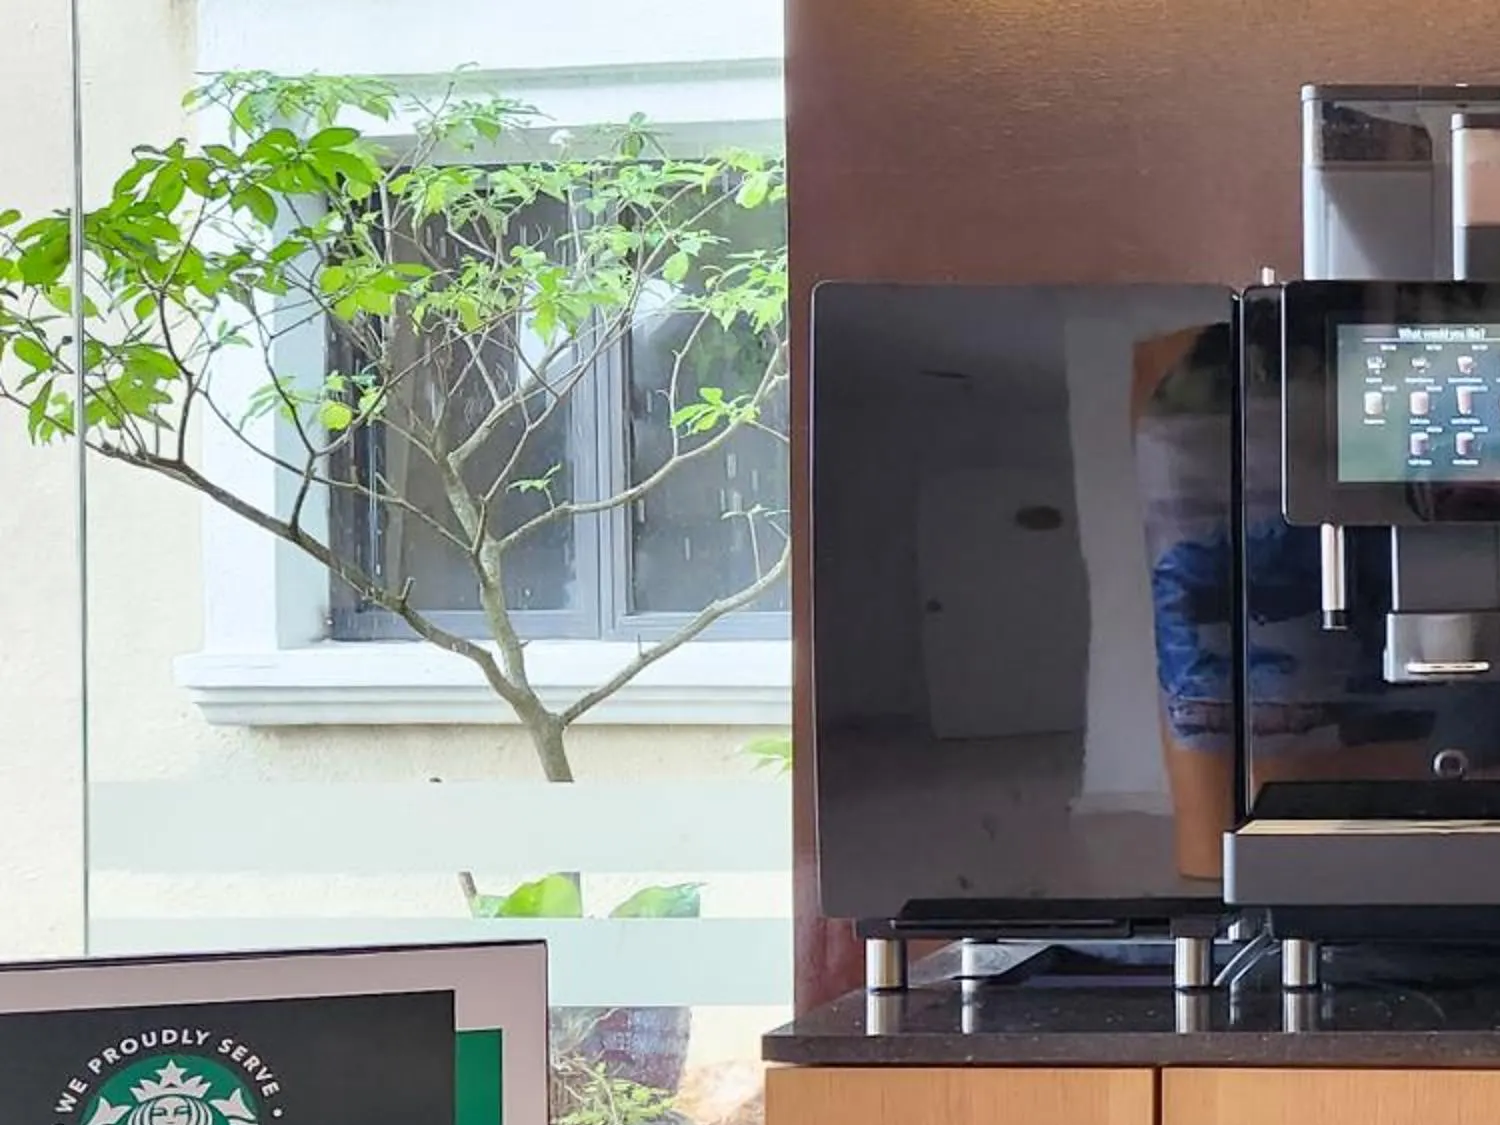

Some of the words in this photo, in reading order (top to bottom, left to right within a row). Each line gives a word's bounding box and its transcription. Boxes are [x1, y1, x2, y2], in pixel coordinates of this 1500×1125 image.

[55, 1077, 88, 1115] WE
[88, 1028, 212, 1075] PROUDLY
[217, 1038, 281, 1099] SERVE
